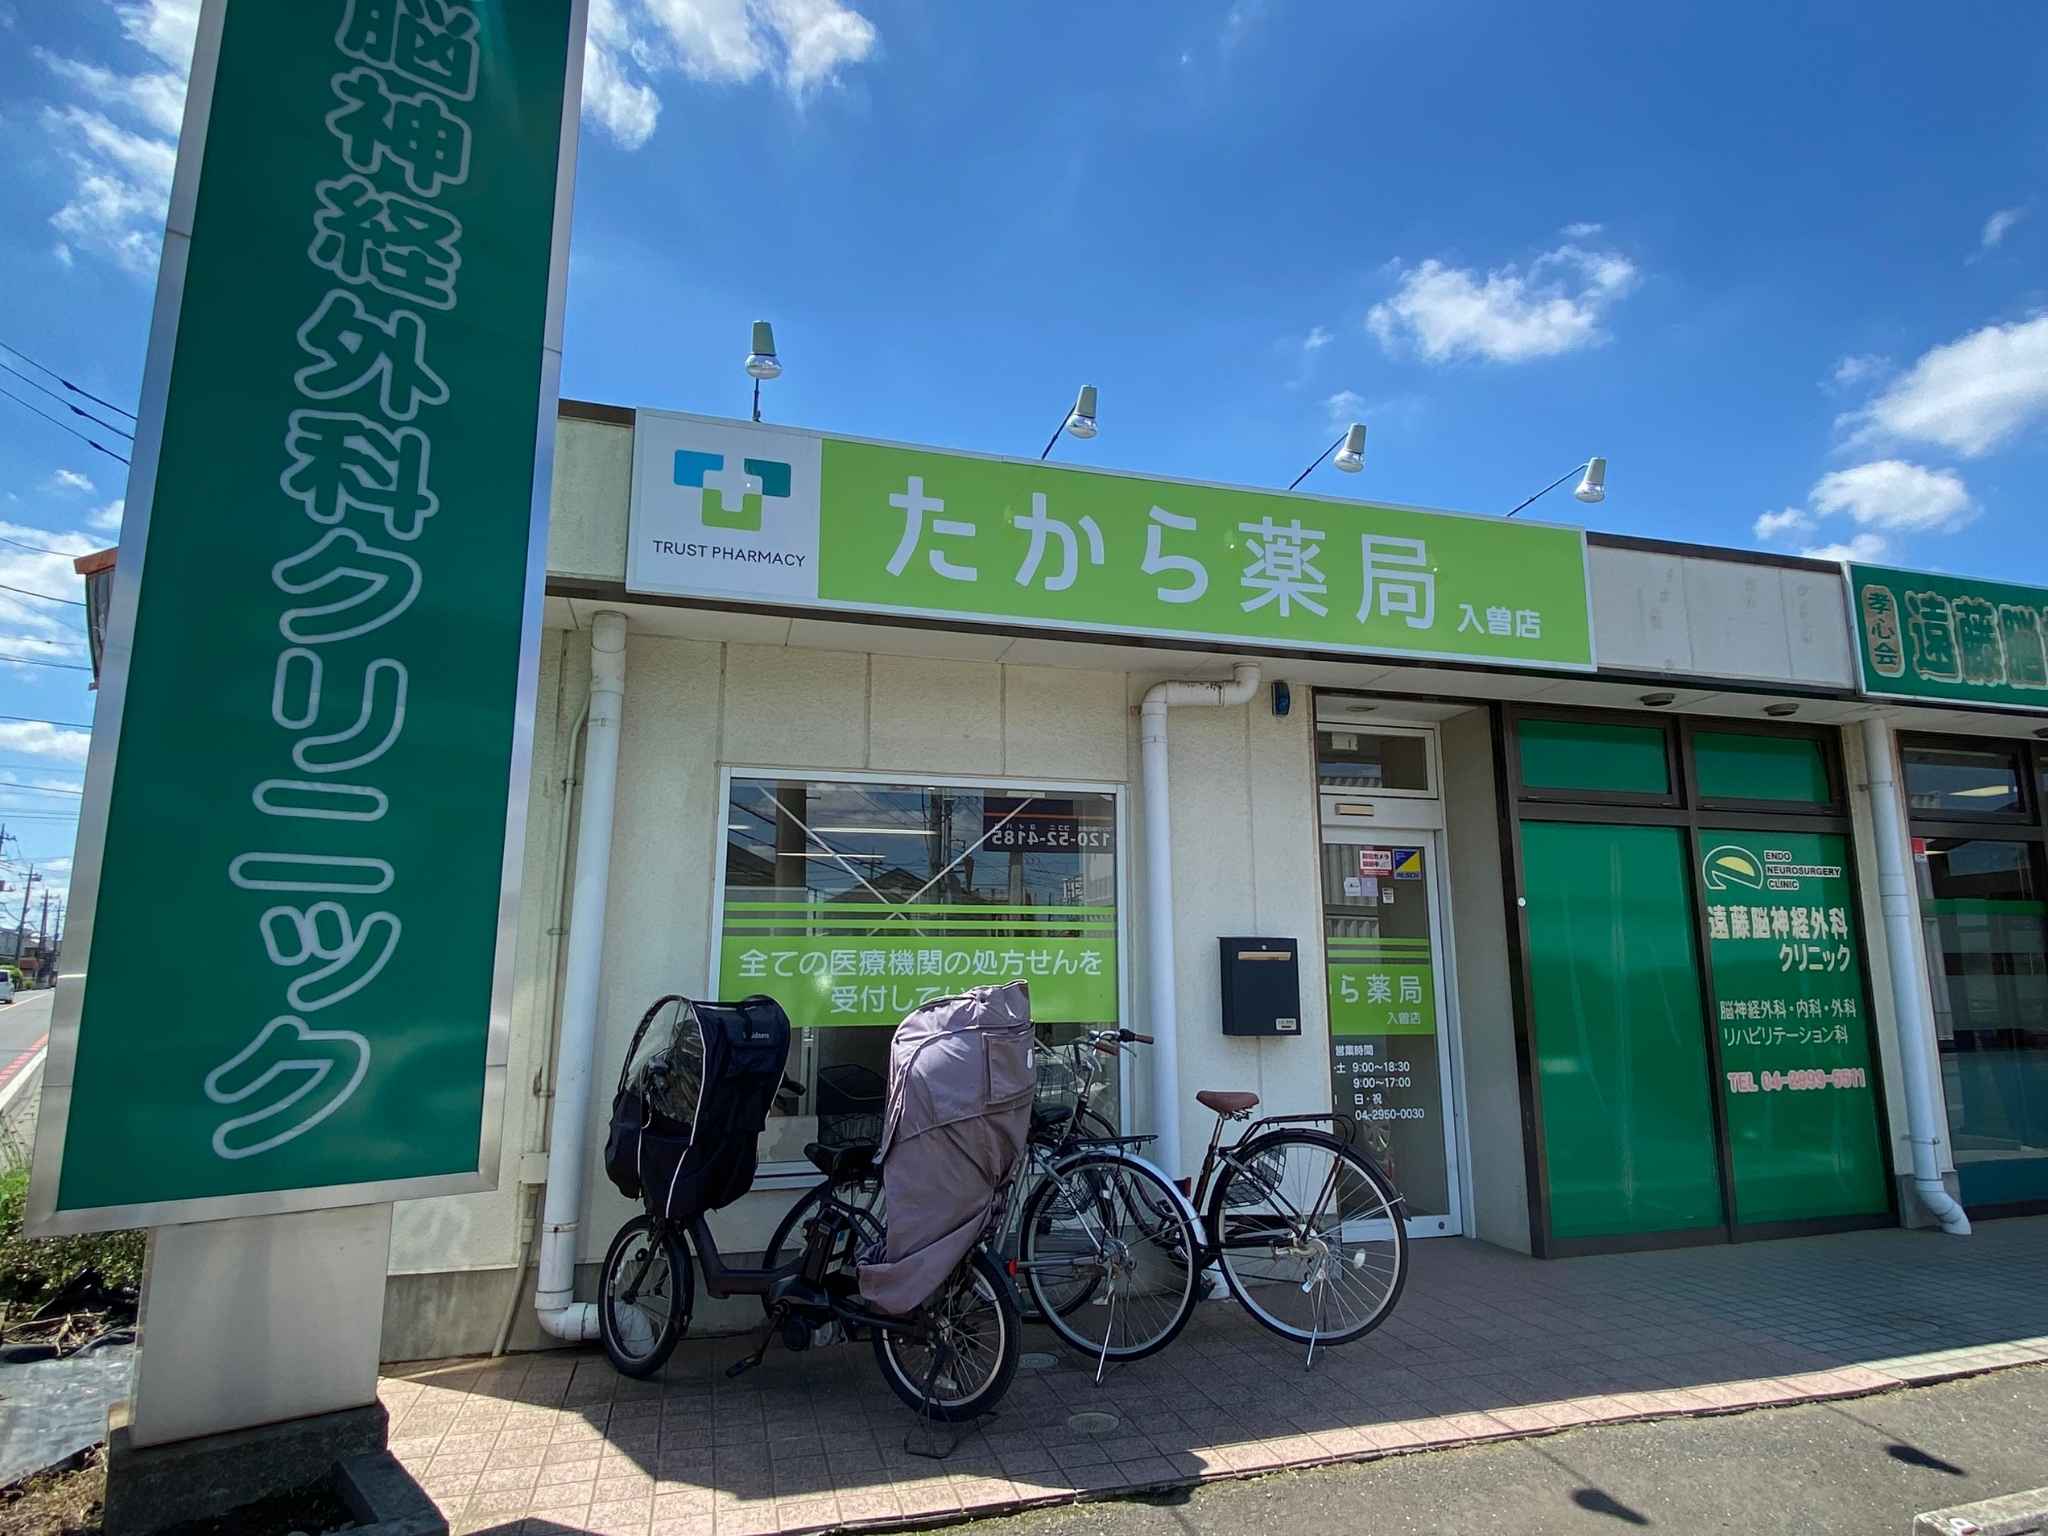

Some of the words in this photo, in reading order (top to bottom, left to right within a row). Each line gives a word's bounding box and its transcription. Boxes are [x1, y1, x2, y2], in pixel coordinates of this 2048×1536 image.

[653, 539, 708, 558] TRUST
[711, 545, 806, 567] PHARMACY
[885, 475, 1435, 630] たから薬局
[1457, 603, 1542, 639] 入曽店
[204, 0, 480, 1159] 脳神経外科クリニック
[1764, 850, 1792, 862] ENDO
[1766, 865, 1841, 878] NEUROSURGERY
[1768, 879, 1799, 890] CLINIC
[1707, 905, 1848, 940] 遠藤脳神経外科
[737, 949, 1103, 977] 全ての医療機関の処方せんを
[1779, 943, 1850, 972] クリニック
[1329, 974, 1421, 1004] ら薬局
[1719, 998, 1856, 1020] 脳神経外科・内科・外科
[1724, 1024, 1848, 1047] リハビリテーション科
